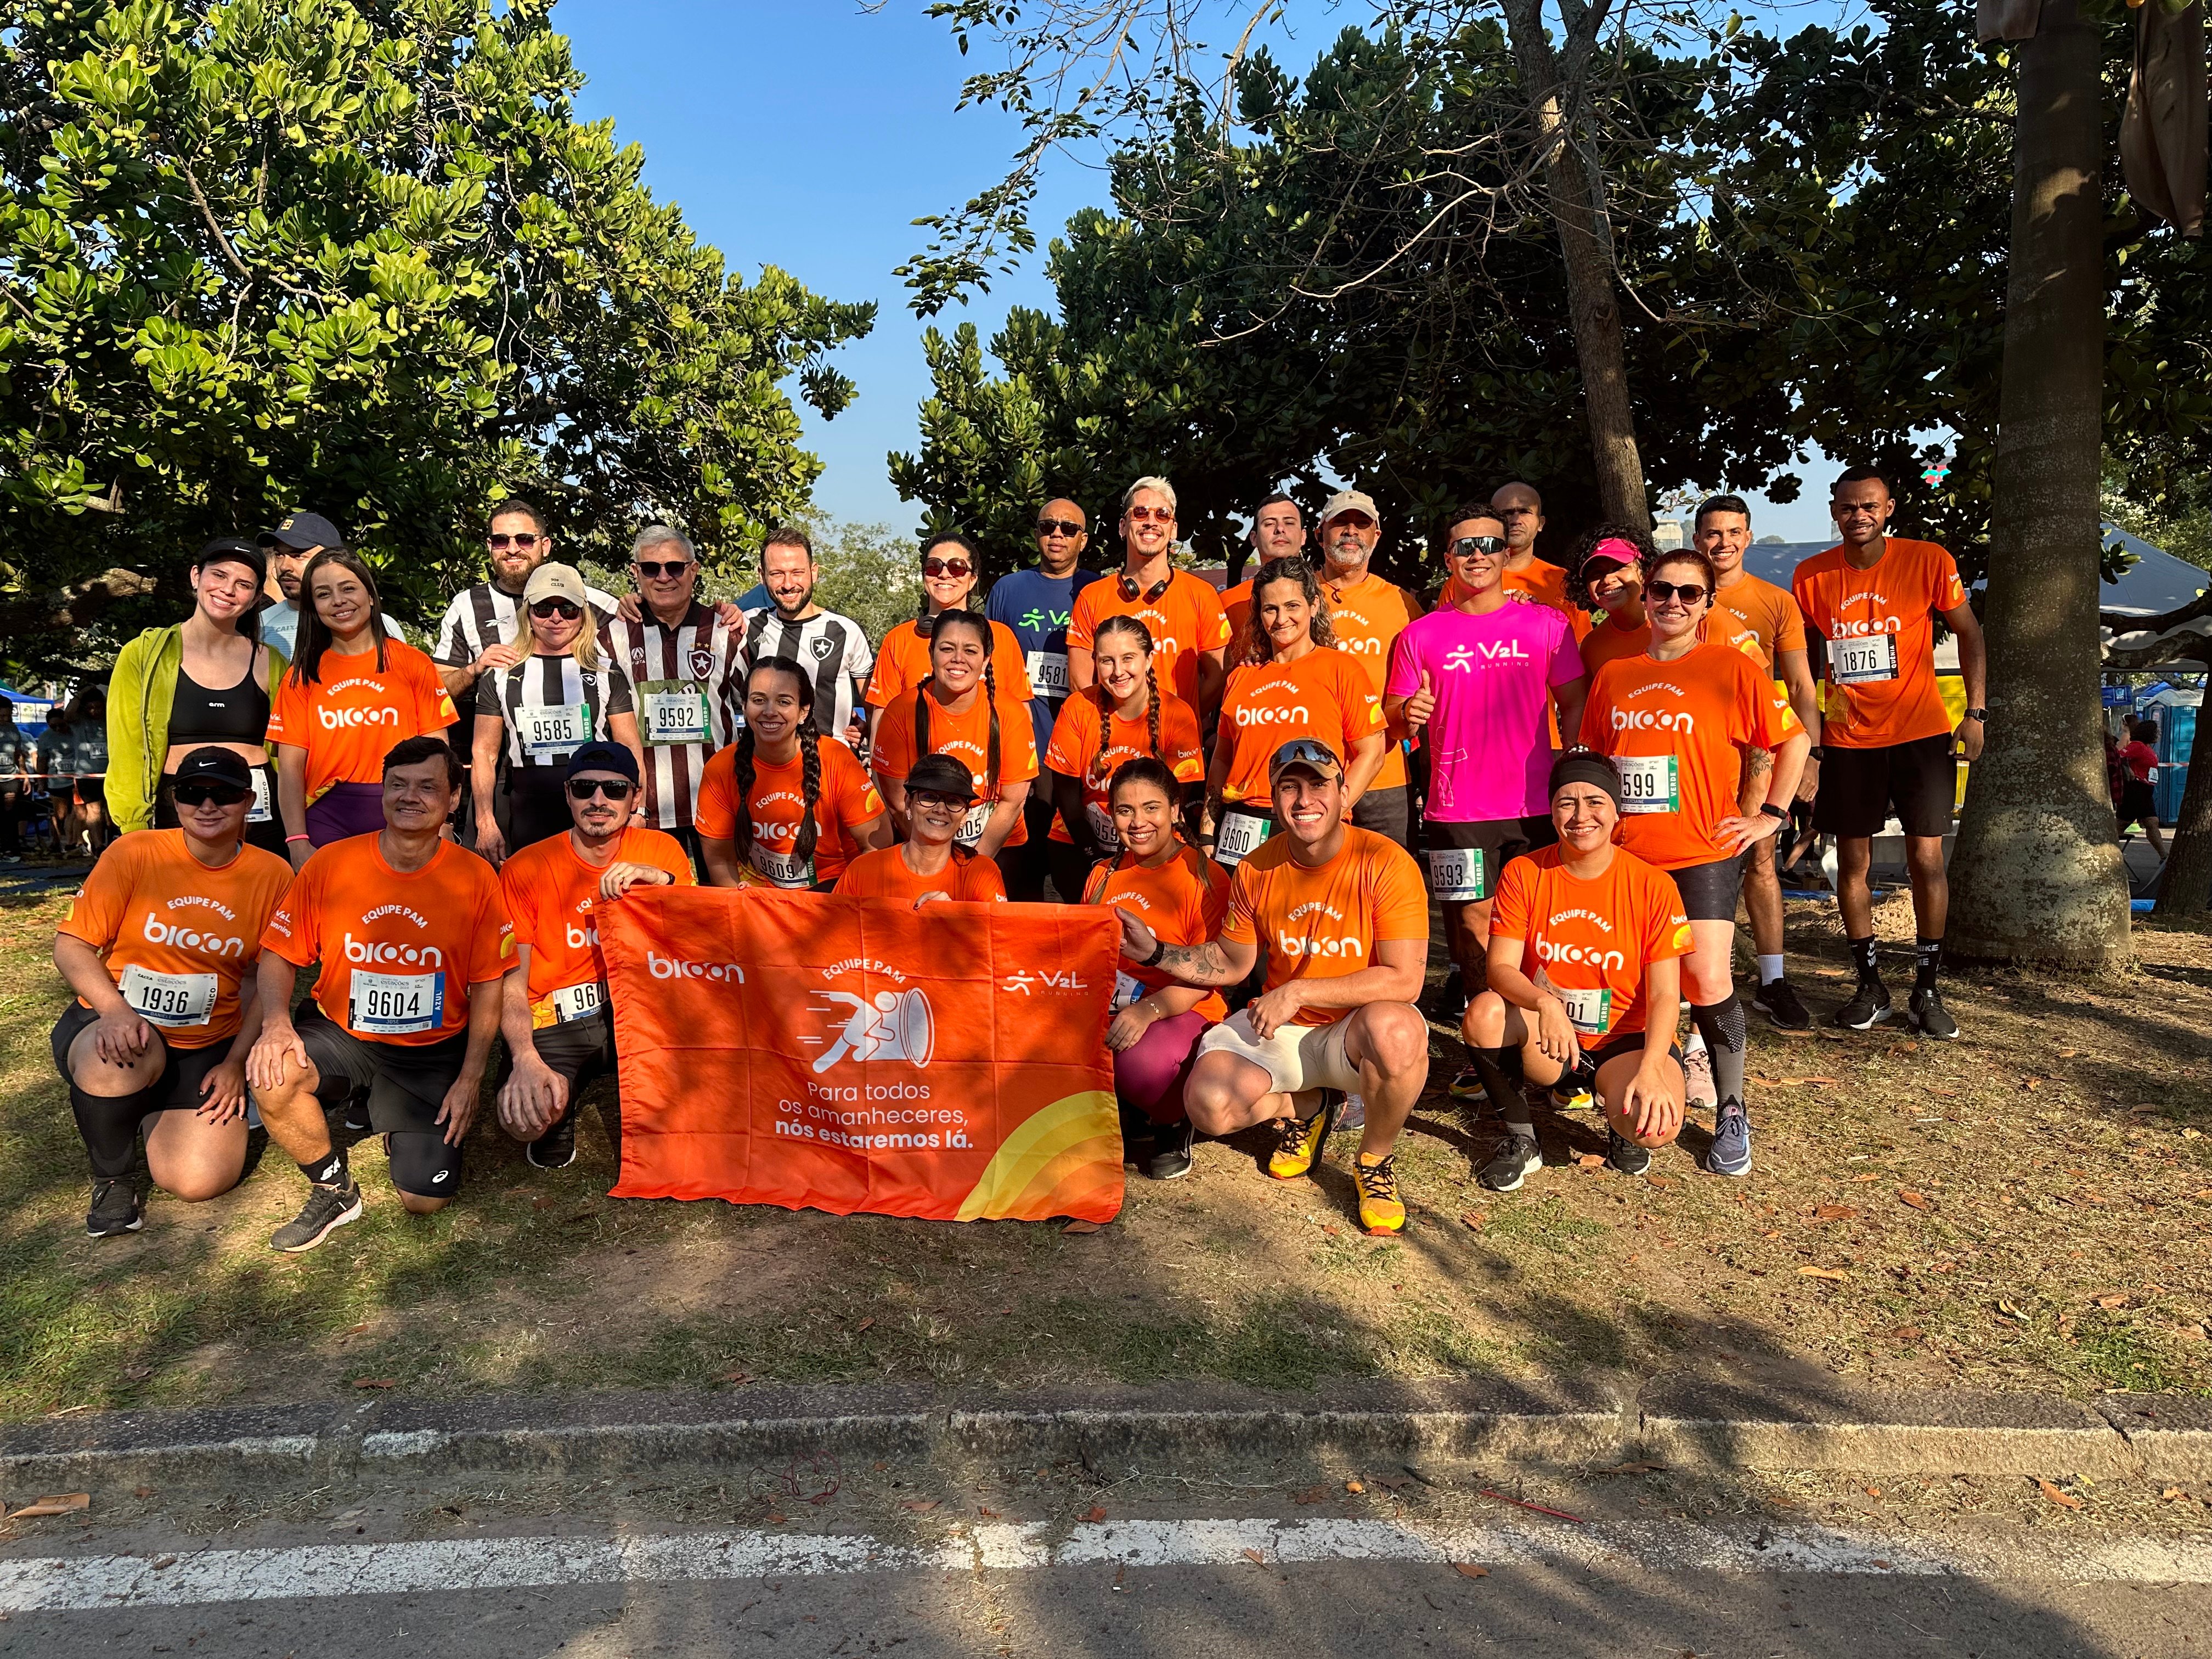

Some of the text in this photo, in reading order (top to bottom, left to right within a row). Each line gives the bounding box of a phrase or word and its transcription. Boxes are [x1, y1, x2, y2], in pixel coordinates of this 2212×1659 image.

[1841, 592, 1887, 611] EQUIPE PAM
[1152, 610, 1167, 625] PAM
[1350, 611, 1369, 627] PAM
[1477, 639, 1530, 659] V2L
[1481, 662, 1529, 670] RUNNING
[1844, 650, 1876, 671] 1876
[1038, 664, 1066, 685] 9581
[327, 678, 385, 696] EQUIPE PAM
[1250, 680, 1300, 697] EQUIPE PAM
[1628, 682, 1685, 699] EQUIPE PAM
[660, 707, 693, 727] 9592
[534, 719, 572, 741] 9585
[964, 741, 984, 757] PAM
[755, 792, 806, 809] EQUIPE PAM
[1222, 827, 1250, 853] 9600
[760, 856, 795, 879] 9609
[1434, 864, 1463, 886] 9593
[166, 896, 236, 921] EQUIPE PAM
[1135, 893, 1151, 911] PAM
[1288, 901, 1322, 922] EQUIPE
[275, 910, 291, 923] V2L
[362, 905, 428, 929] EQUIPE PAM
[1549, 909, 1613, 933] EQUIPE PAM
[822, 958, 906, 984] EQUIPE PAM
[1038, 970, 1088, 989] V2L
[142, 986, 189, 1014] 1936
[204, 988, 216, 1015] BRANCO
[368, 990, 420, 1017] 9604
[435, 990, 443, 1011] AZUL
[807, 1081, 931, 1102] Para todos
[779, 1099, 969, 1127] os amanheceres,
[775, 1119, 974, 1149] nós estaremos lá.
